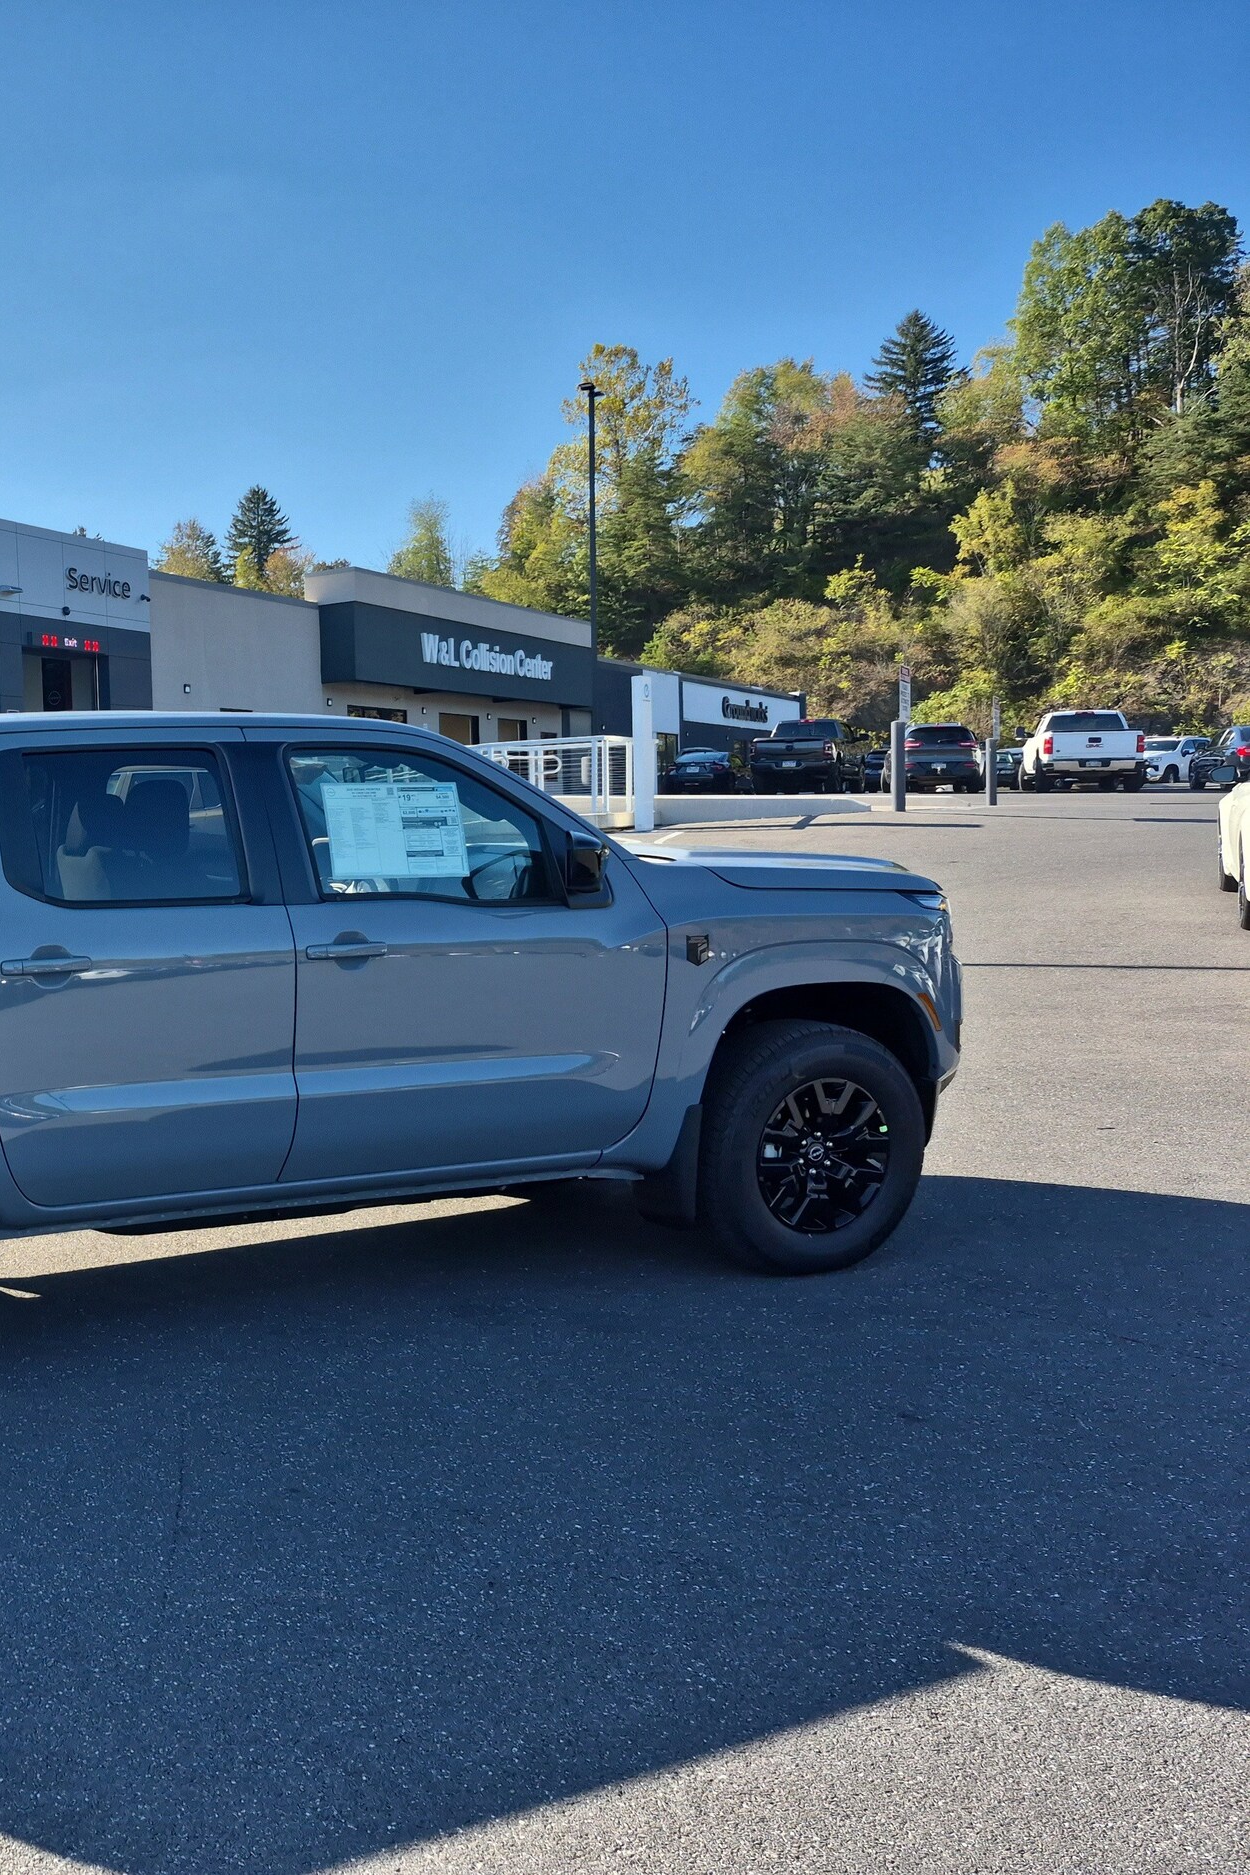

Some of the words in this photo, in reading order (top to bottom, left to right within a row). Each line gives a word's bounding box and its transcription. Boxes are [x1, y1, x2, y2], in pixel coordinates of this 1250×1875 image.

[65, 567, 131, 599] Service
[64, 637, 78, 648] Exit
[420, 632, 459, 667] W&L
[460, 640, 514, 675] Collision
[514, 650, 553, 680] Center
